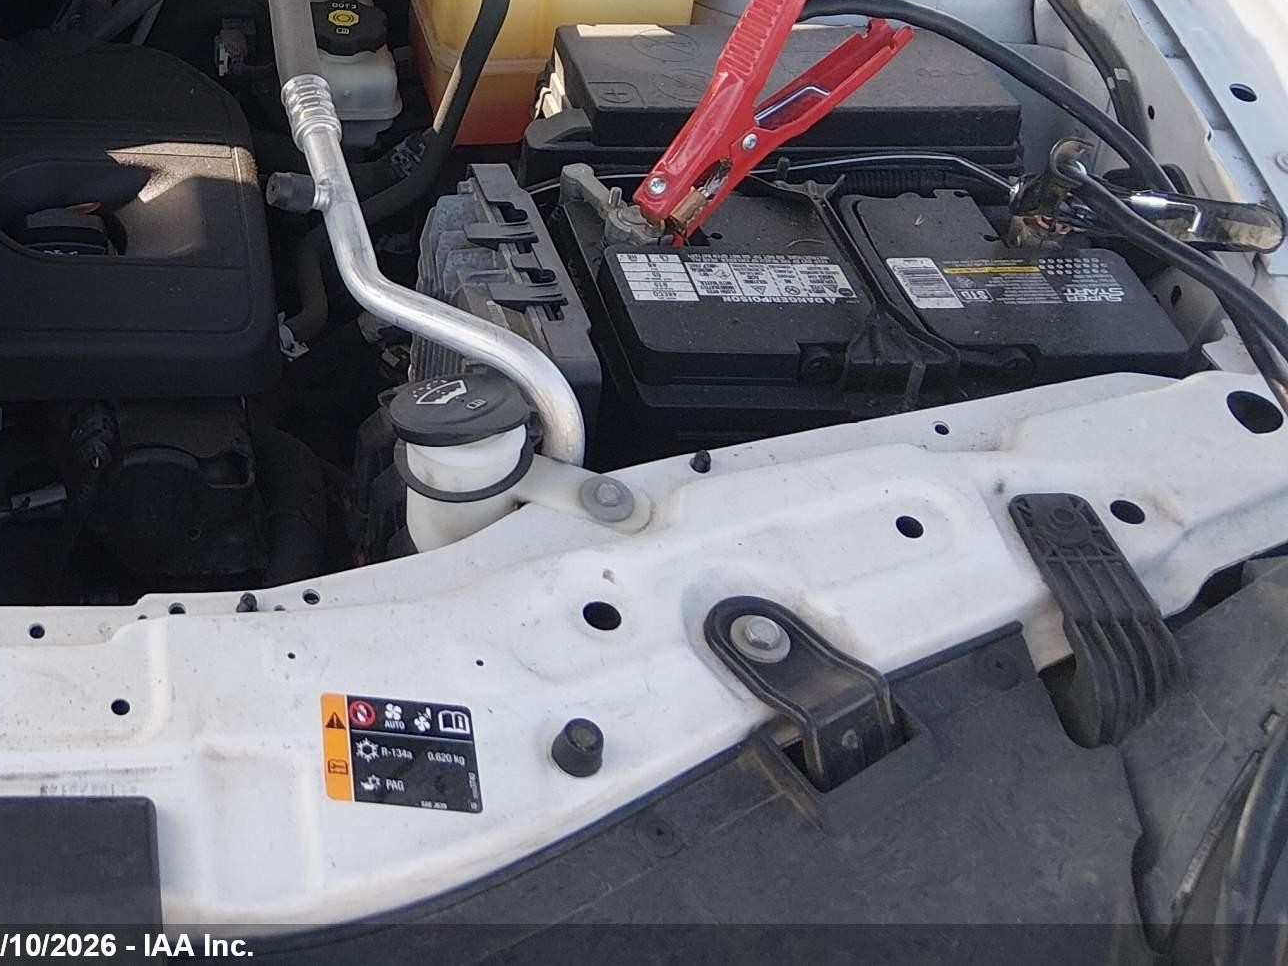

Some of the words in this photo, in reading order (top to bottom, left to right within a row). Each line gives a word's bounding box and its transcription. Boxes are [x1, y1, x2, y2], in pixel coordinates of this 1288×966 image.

[1063, 287, 1125, 296] START
[1066, 294, 1122, 302] SUPER
[384, 720, 405, 730] AUTO
[381, 746, 413, 759] R-134a
[427, 751, 452, 763] 0.620
[385, 778, 405, 792] PAG
